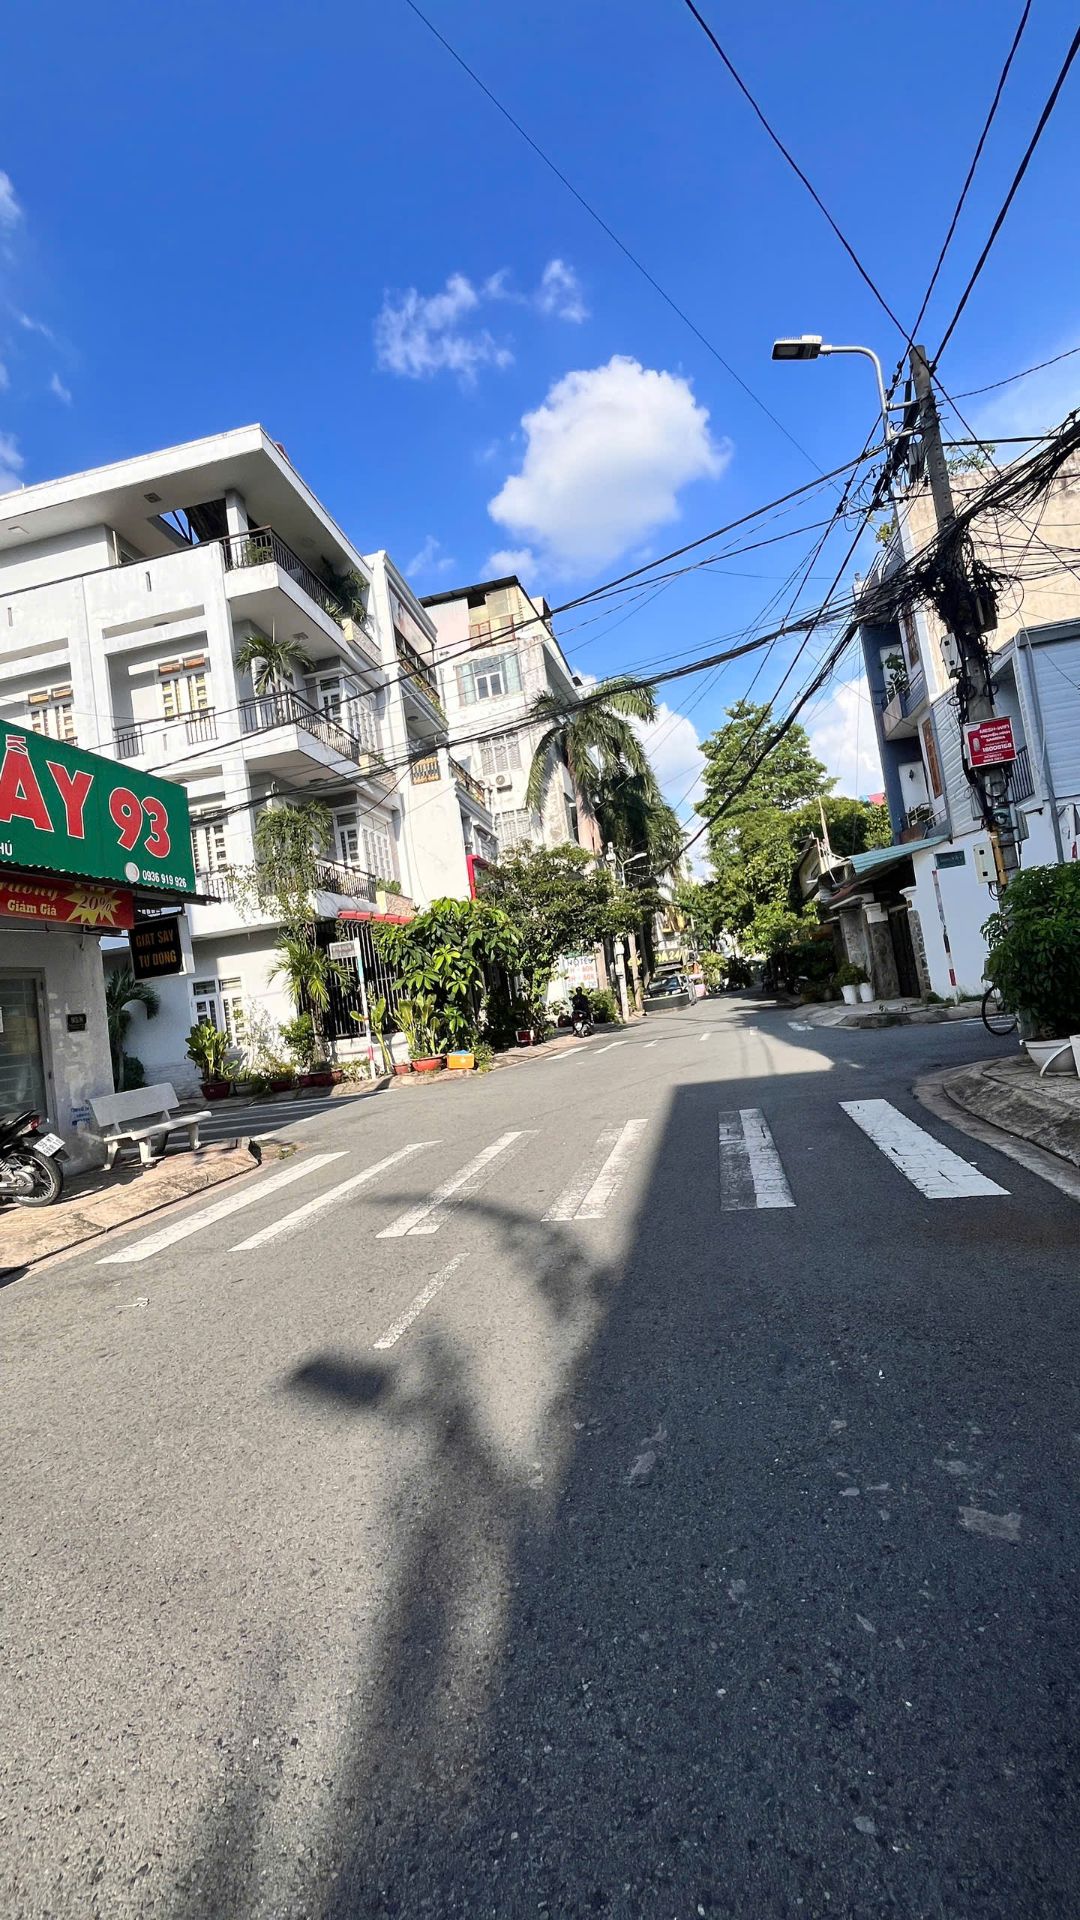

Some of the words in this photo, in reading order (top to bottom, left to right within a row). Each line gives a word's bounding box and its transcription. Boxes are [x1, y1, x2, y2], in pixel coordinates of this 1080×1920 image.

[108, 786, 171, 859] 93
[142, 870, 160, 883] 0936
[161, 873, 174, 885] 919
[174, 876, 187, 888] 926
[78, 894, 112, 912] 20%
